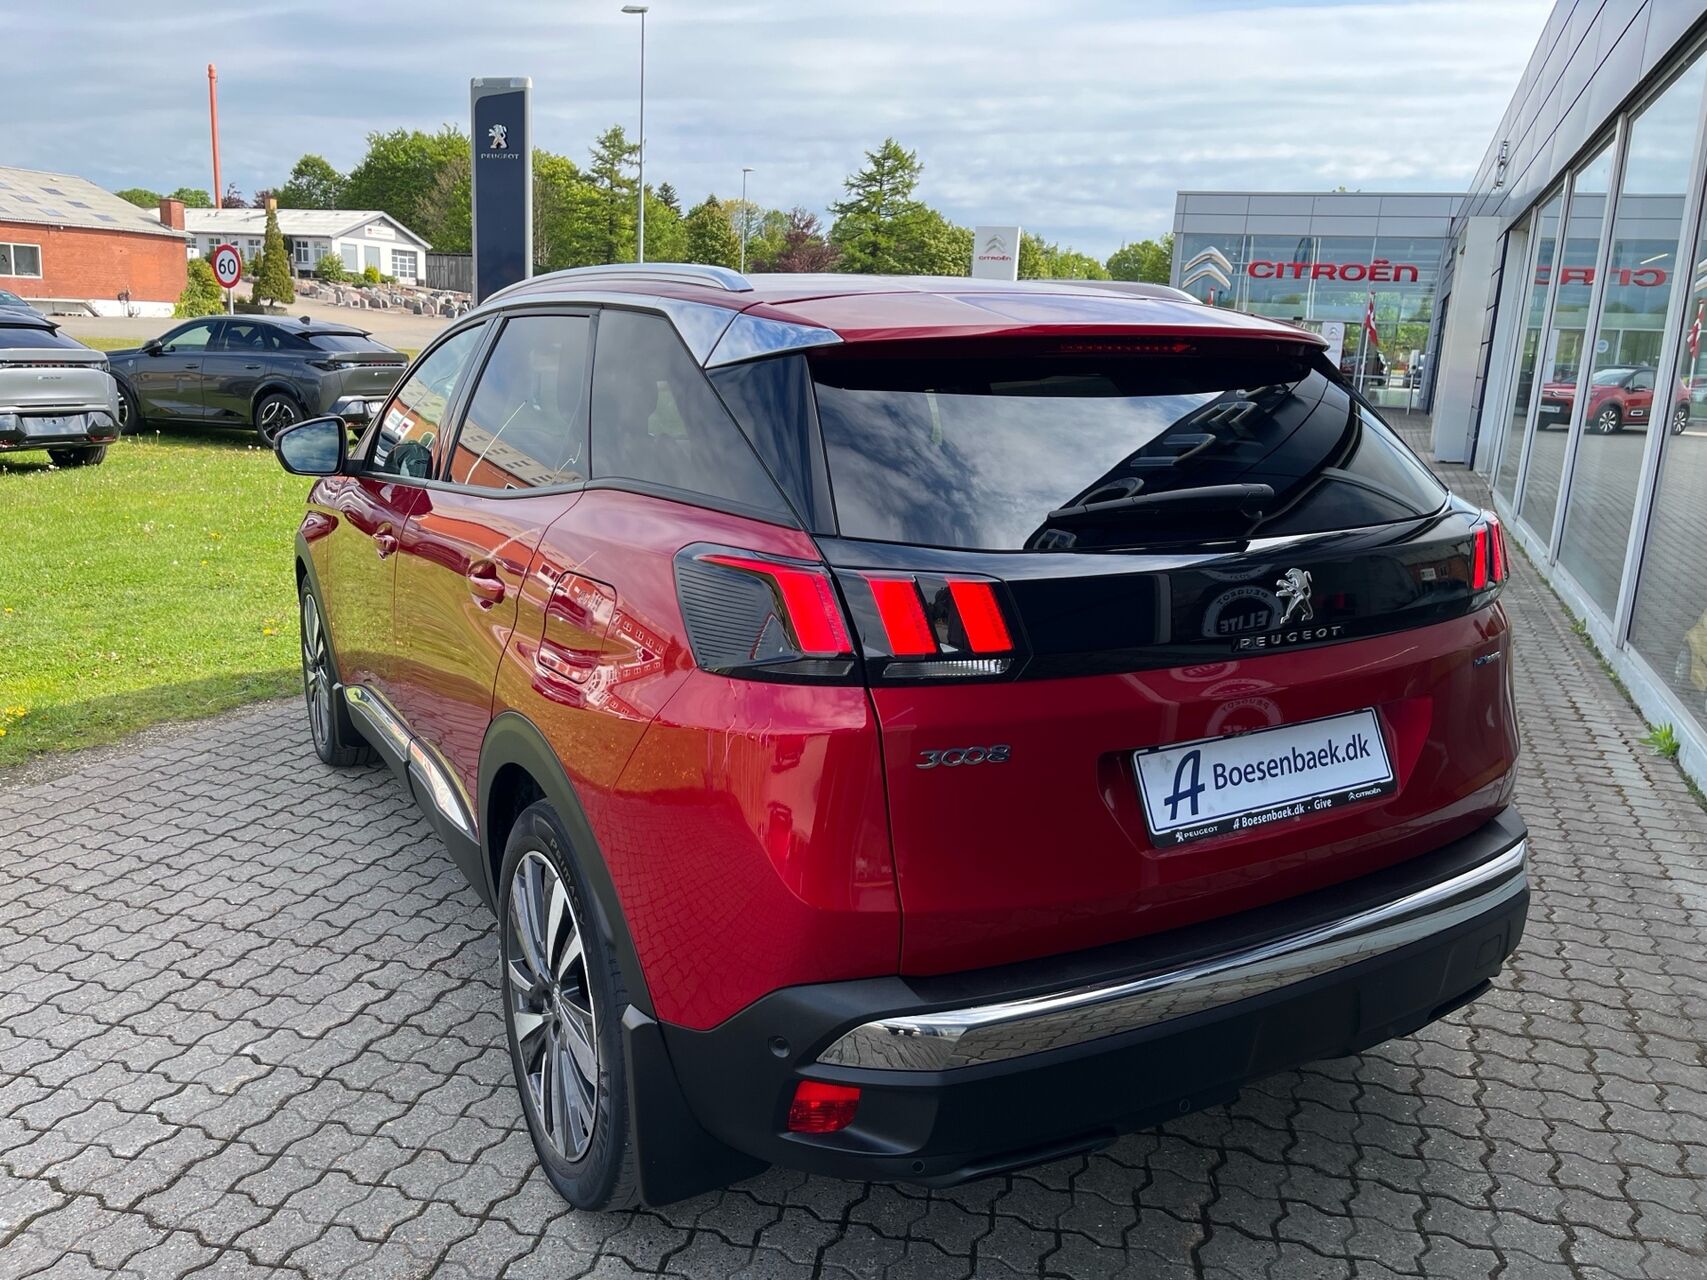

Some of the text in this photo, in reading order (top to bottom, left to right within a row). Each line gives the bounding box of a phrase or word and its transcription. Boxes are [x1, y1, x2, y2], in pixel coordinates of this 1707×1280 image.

[218, 258, 237, 275] 60
[1239, 625, 1342, 648] PEUGEOT
[916, 745, 1011, 769] 3008
[1164, 733, 1371, 820] A Boesenbaek.dk
[1242, 803, 1305, 828] Boesenbaek.dk
[1314, 799, 1332, 810] Give
[1184, 826, 1219, 839] PEUGEOT
